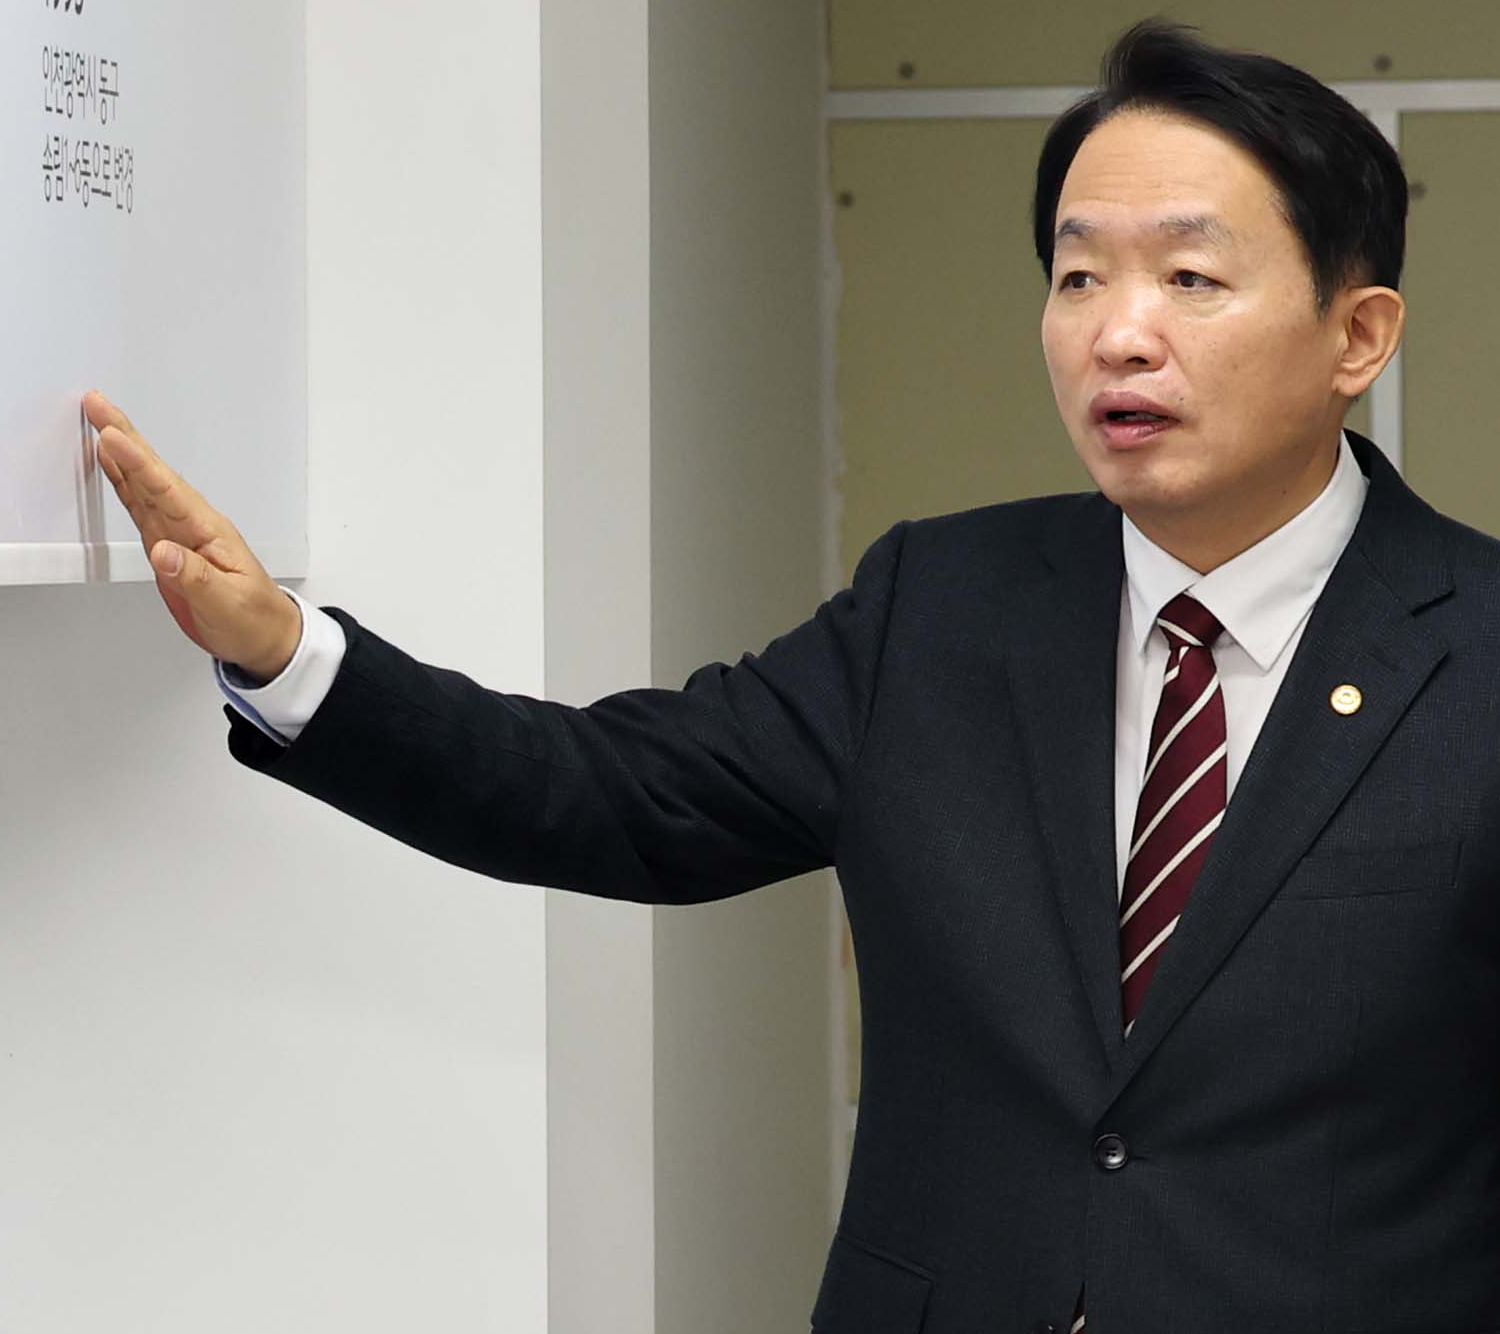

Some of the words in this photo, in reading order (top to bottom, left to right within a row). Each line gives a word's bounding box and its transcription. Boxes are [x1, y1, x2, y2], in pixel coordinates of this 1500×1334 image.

[42, 45, 96, 119] 인천광역시
[98, 58, 120, 125] 동구
[42, 135, 112, 208] 송림1~6동으로
[113, 147, 134, 215] 변경
